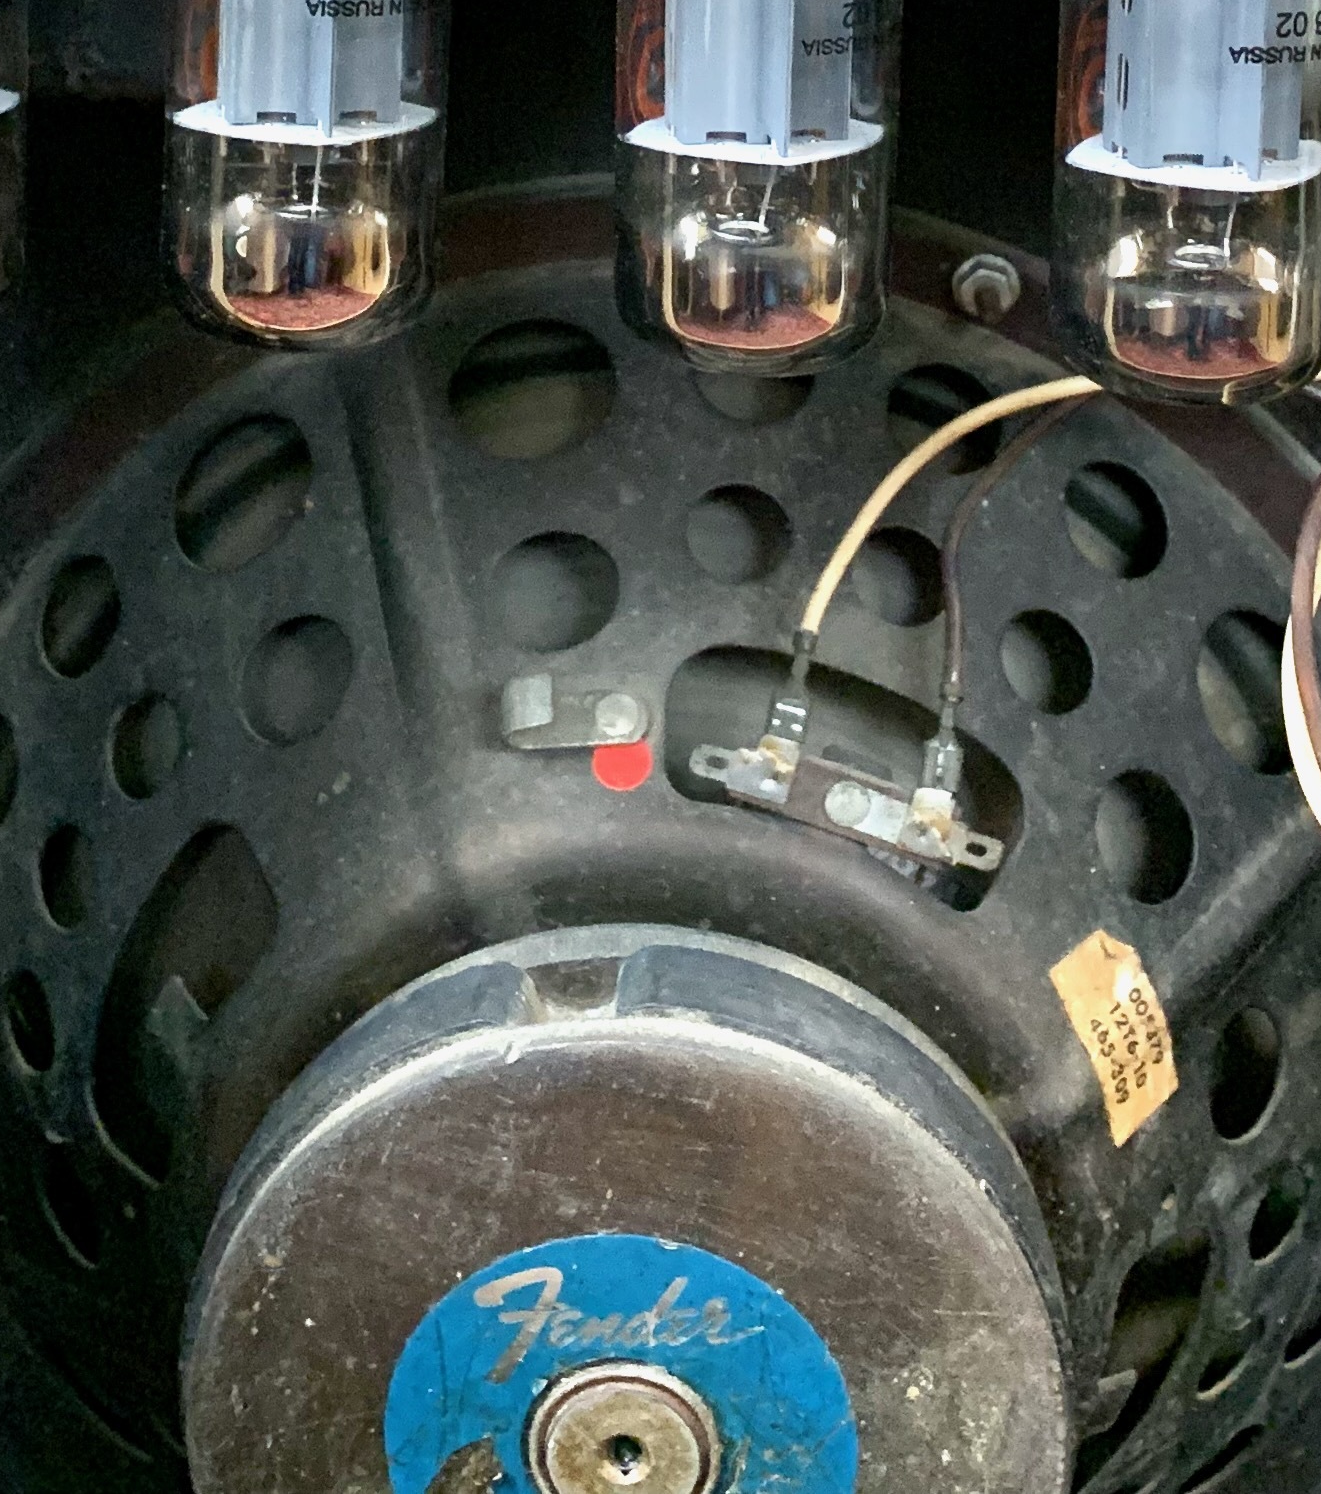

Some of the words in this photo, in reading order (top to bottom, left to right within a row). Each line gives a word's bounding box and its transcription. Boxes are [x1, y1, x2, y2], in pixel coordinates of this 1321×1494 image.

[1275, 11, 1309, 38] 02
[1229, 43, 1307, 65] RUSSIA
[472, 1266, 766, 1385] Fender
